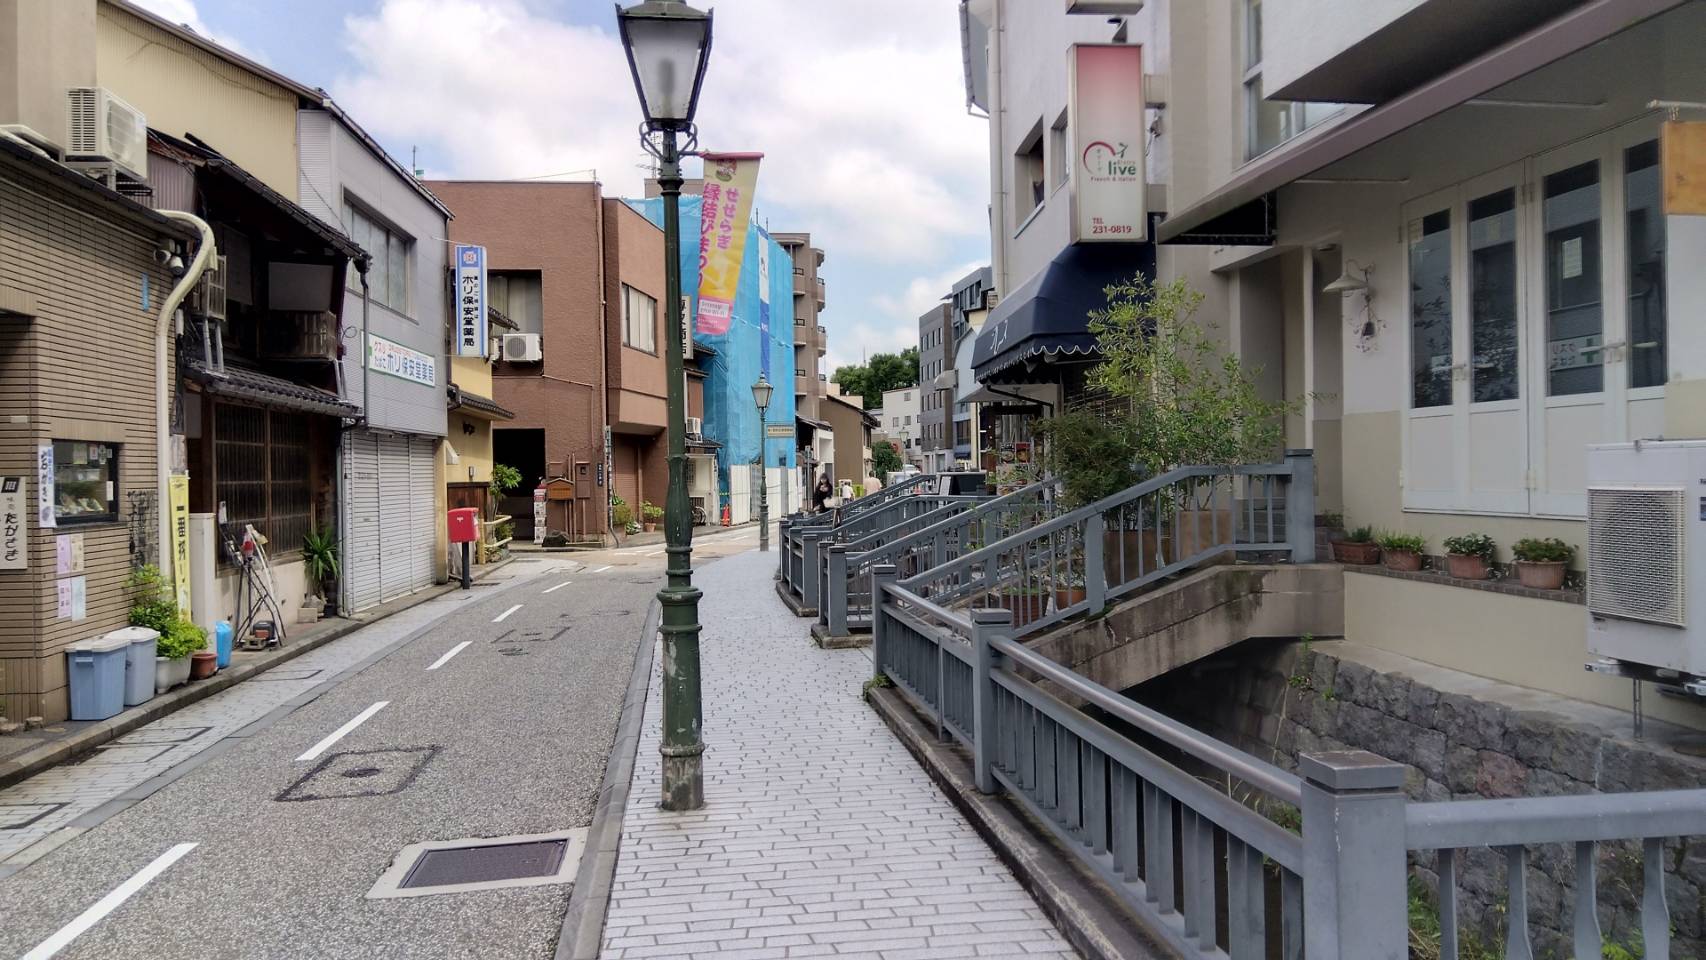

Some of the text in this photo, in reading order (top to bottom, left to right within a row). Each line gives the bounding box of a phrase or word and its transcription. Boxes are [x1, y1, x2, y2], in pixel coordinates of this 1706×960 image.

[717, 187, 739, 250] せせらぎ
[1092, 225, 1132, 234] 231-0819
[463, 275, 475, 347] ホリ保安堂薬局
